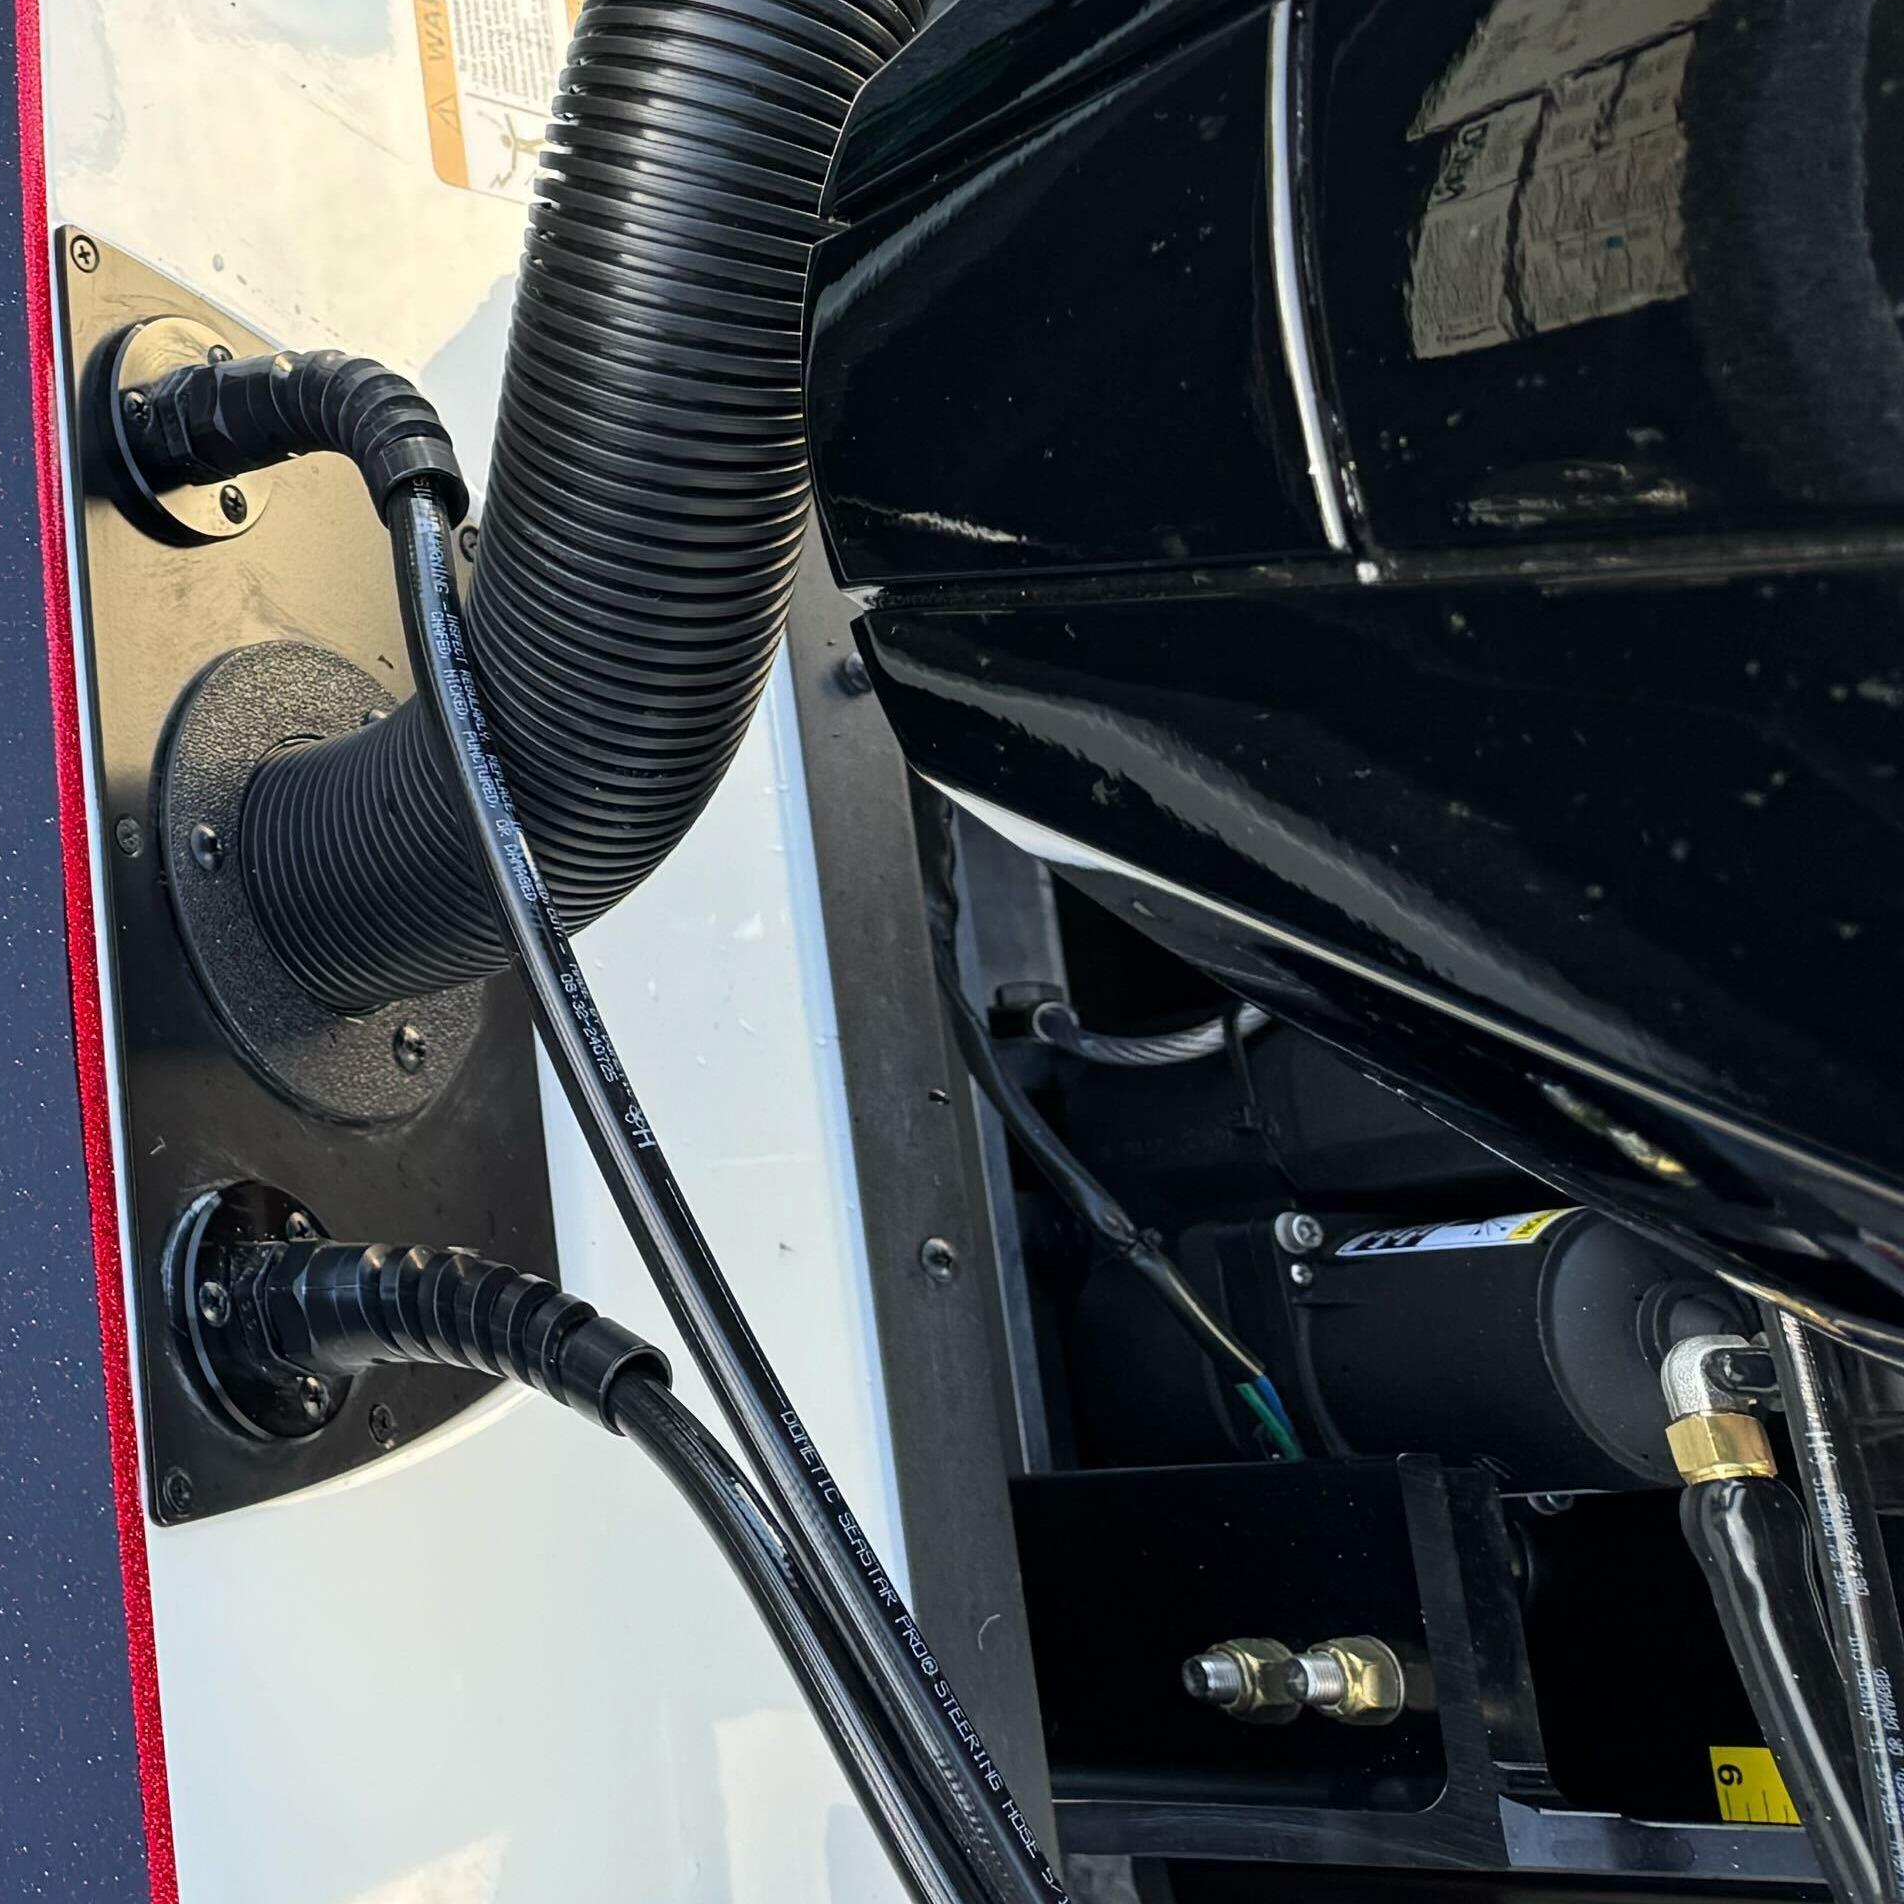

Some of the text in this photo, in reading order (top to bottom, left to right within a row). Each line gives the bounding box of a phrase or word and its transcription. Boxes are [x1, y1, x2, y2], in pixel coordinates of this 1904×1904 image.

[780, 1409, 841, 1504] DOMETIC
[837, 1511, 899, 1608] SEASTAR
[933, 1679, 1004, 1793] STEERING
[1001, 1799, 1043, 1859] HOSE
